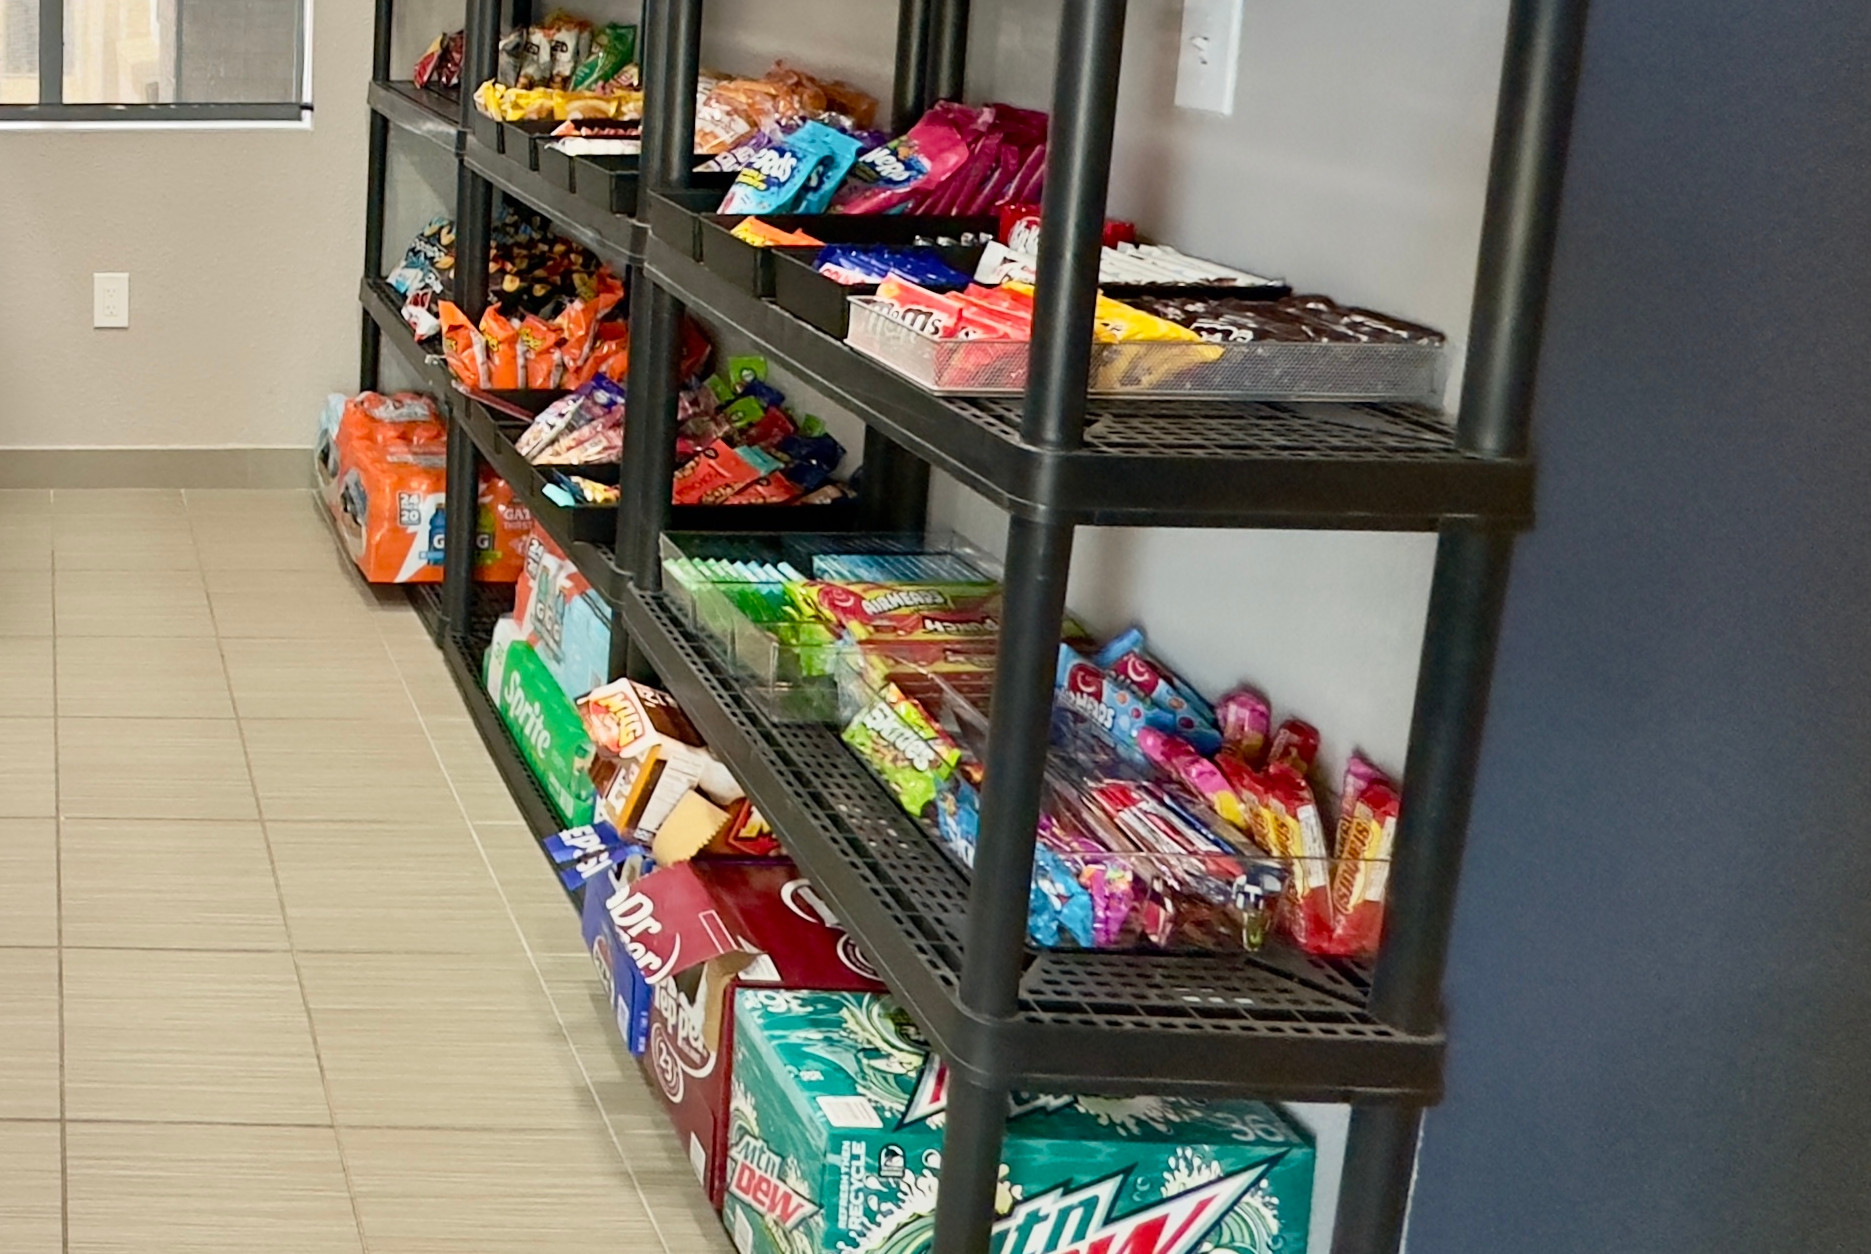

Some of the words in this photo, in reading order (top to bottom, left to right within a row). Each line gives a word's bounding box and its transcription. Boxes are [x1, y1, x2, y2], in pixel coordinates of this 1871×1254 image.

[400, 493, 420, 505] 24
[400, 510, 419, 522] 20
[432, 534, 446, 550] G
[476, 534, 490, 549] G
[861, 589, 946, 616] AIRHEADS
[504, 669, 553, 760] Sprite
[599, 691, 644, 749] MUG
[862, 704, 936, 772] Skittles
[560, 824, 611, 880] EPSI
[610, 891, 663, 938] Dr
[840, 1140, 851, 1175] THEN
[731, 1162, 806, 1227] DEW
[837, 1174, 850, 1230] REFRESH
[847, 1140, 866, 1230] RECYCLE
